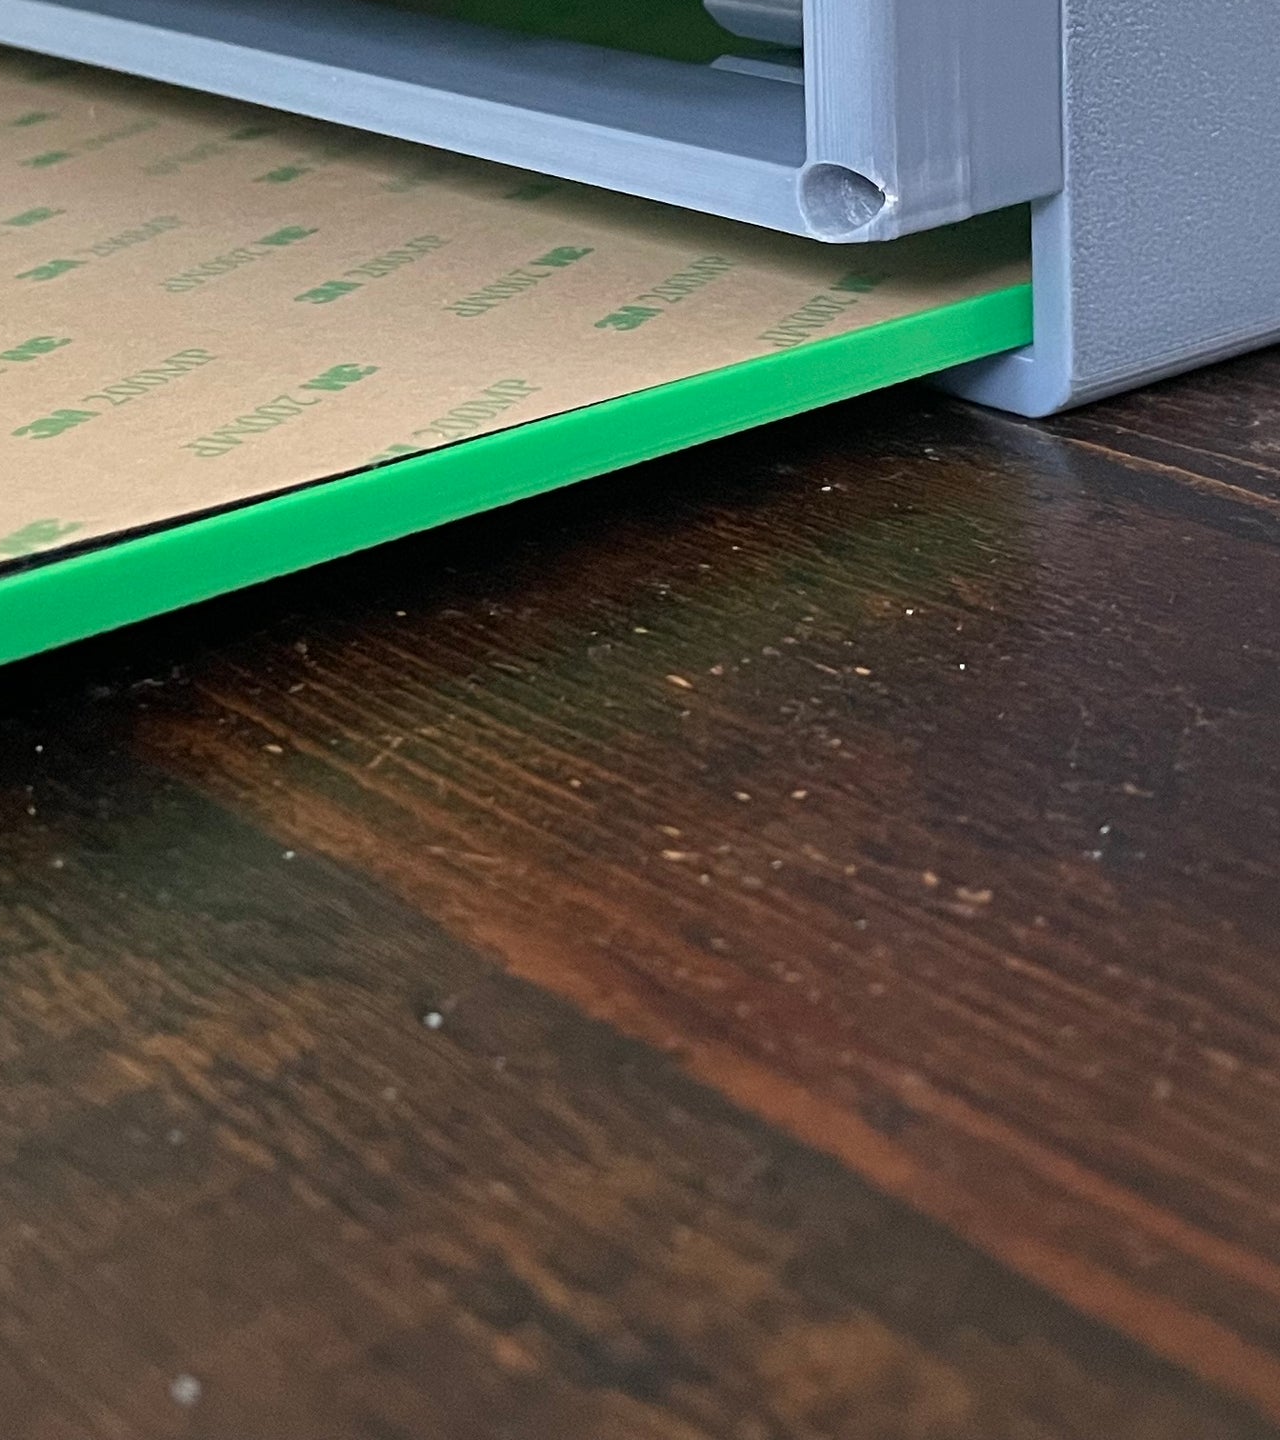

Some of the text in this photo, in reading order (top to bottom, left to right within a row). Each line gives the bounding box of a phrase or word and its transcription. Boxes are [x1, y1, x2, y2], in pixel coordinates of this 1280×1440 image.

[158, 226, 319, 294] 3M 200MP
[294, 234, 452, 304] 3M 200MP
[441, 246, 594, 317] 3M 200MP
[594, 256, 733, 331] 3M 200MP
[757, 295, 858, 348] 200MP
[12, 348, 219, 439] 3M 200MP
[299, 364, 378, 392] 3M
[180, 393, 323, 459] 200MP
